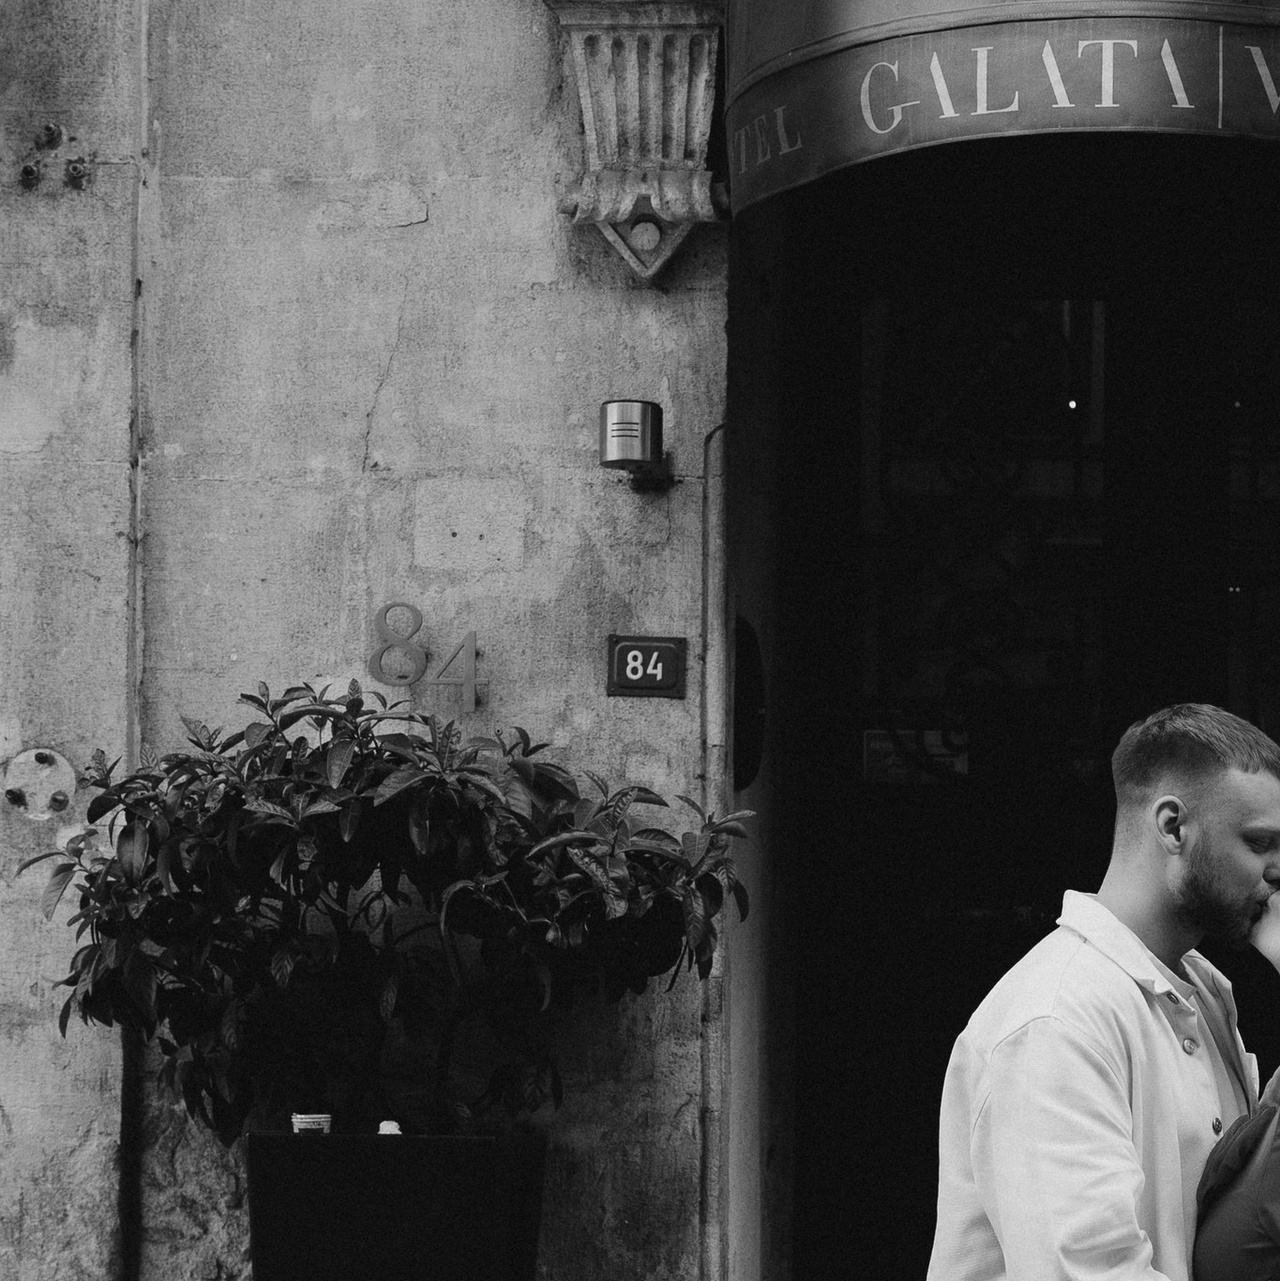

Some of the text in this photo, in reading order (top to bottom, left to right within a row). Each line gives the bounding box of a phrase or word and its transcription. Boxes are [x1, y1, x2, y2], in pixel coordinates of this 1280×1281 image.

[859, 39, 1197, 137] GALATA
[368, 602, 490, 712] 84
[626, 650, 663, 681] 84
